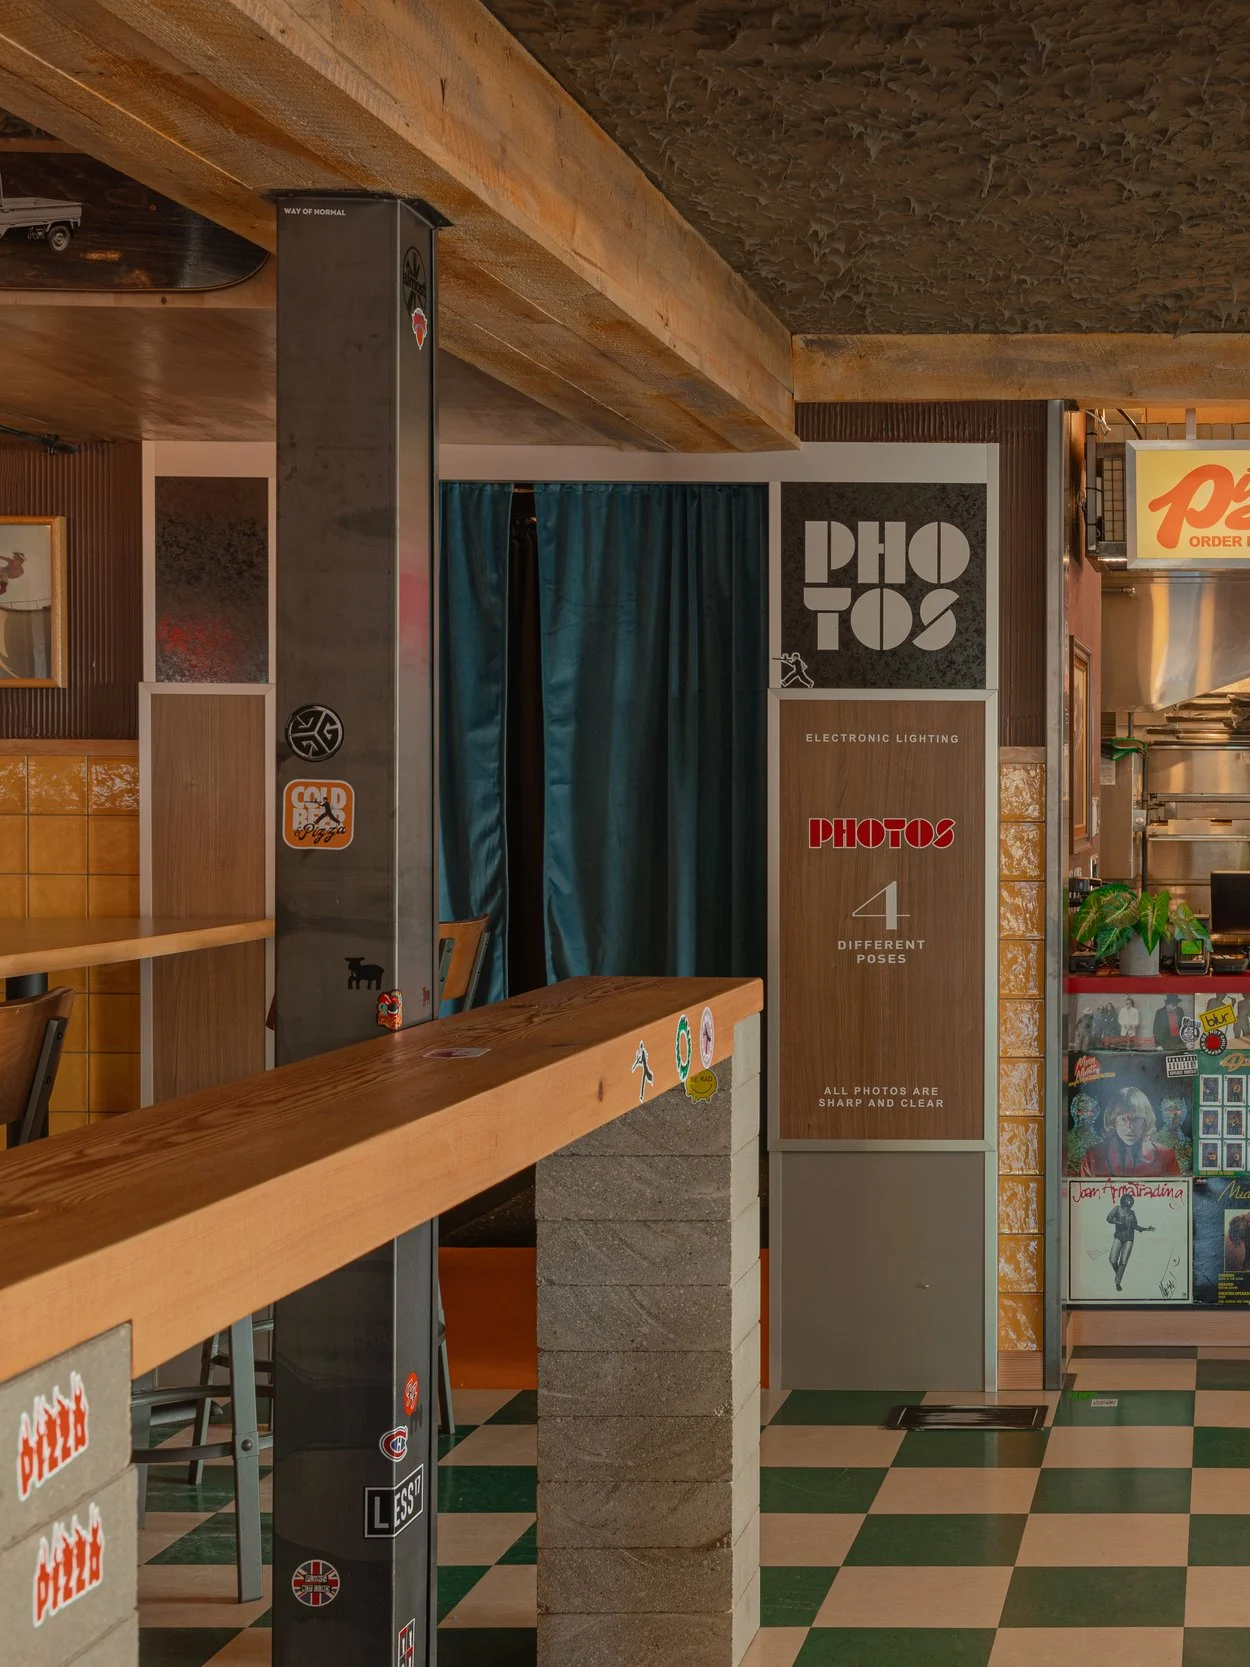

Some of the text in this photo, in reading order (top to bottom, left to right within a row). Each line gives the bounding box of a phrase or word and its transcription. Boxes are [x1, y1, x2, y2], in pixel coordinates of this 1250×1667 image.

[283, 207, 347, 217] WAY OF NORMAL
[1189, 535, 1243, 548] ORDER
[804, 520, 971, 584] PHO
[803, 587, 960, 651] TOS
[806, 733, 959, 743] ELECTRONIC LIGHTING
[290, 785, 347, 810] COLD
[809, 818, 956, 849] PHOTOS
[852, 880, 910, 930] 4
[837, 940, 926, 950] DIFFERENT
[856, 954, 907, 964] POSES
[1205, 1012, 1230, 1028] blur
[700, 1075, 713, 1083] RAD
[823, 1087, 939, 1096] ALL PHOTOS ARE
[818, 1098, 944, 1108] SHARP AND CLEAR
[1072, 1182, 1101, 1203] Joan
